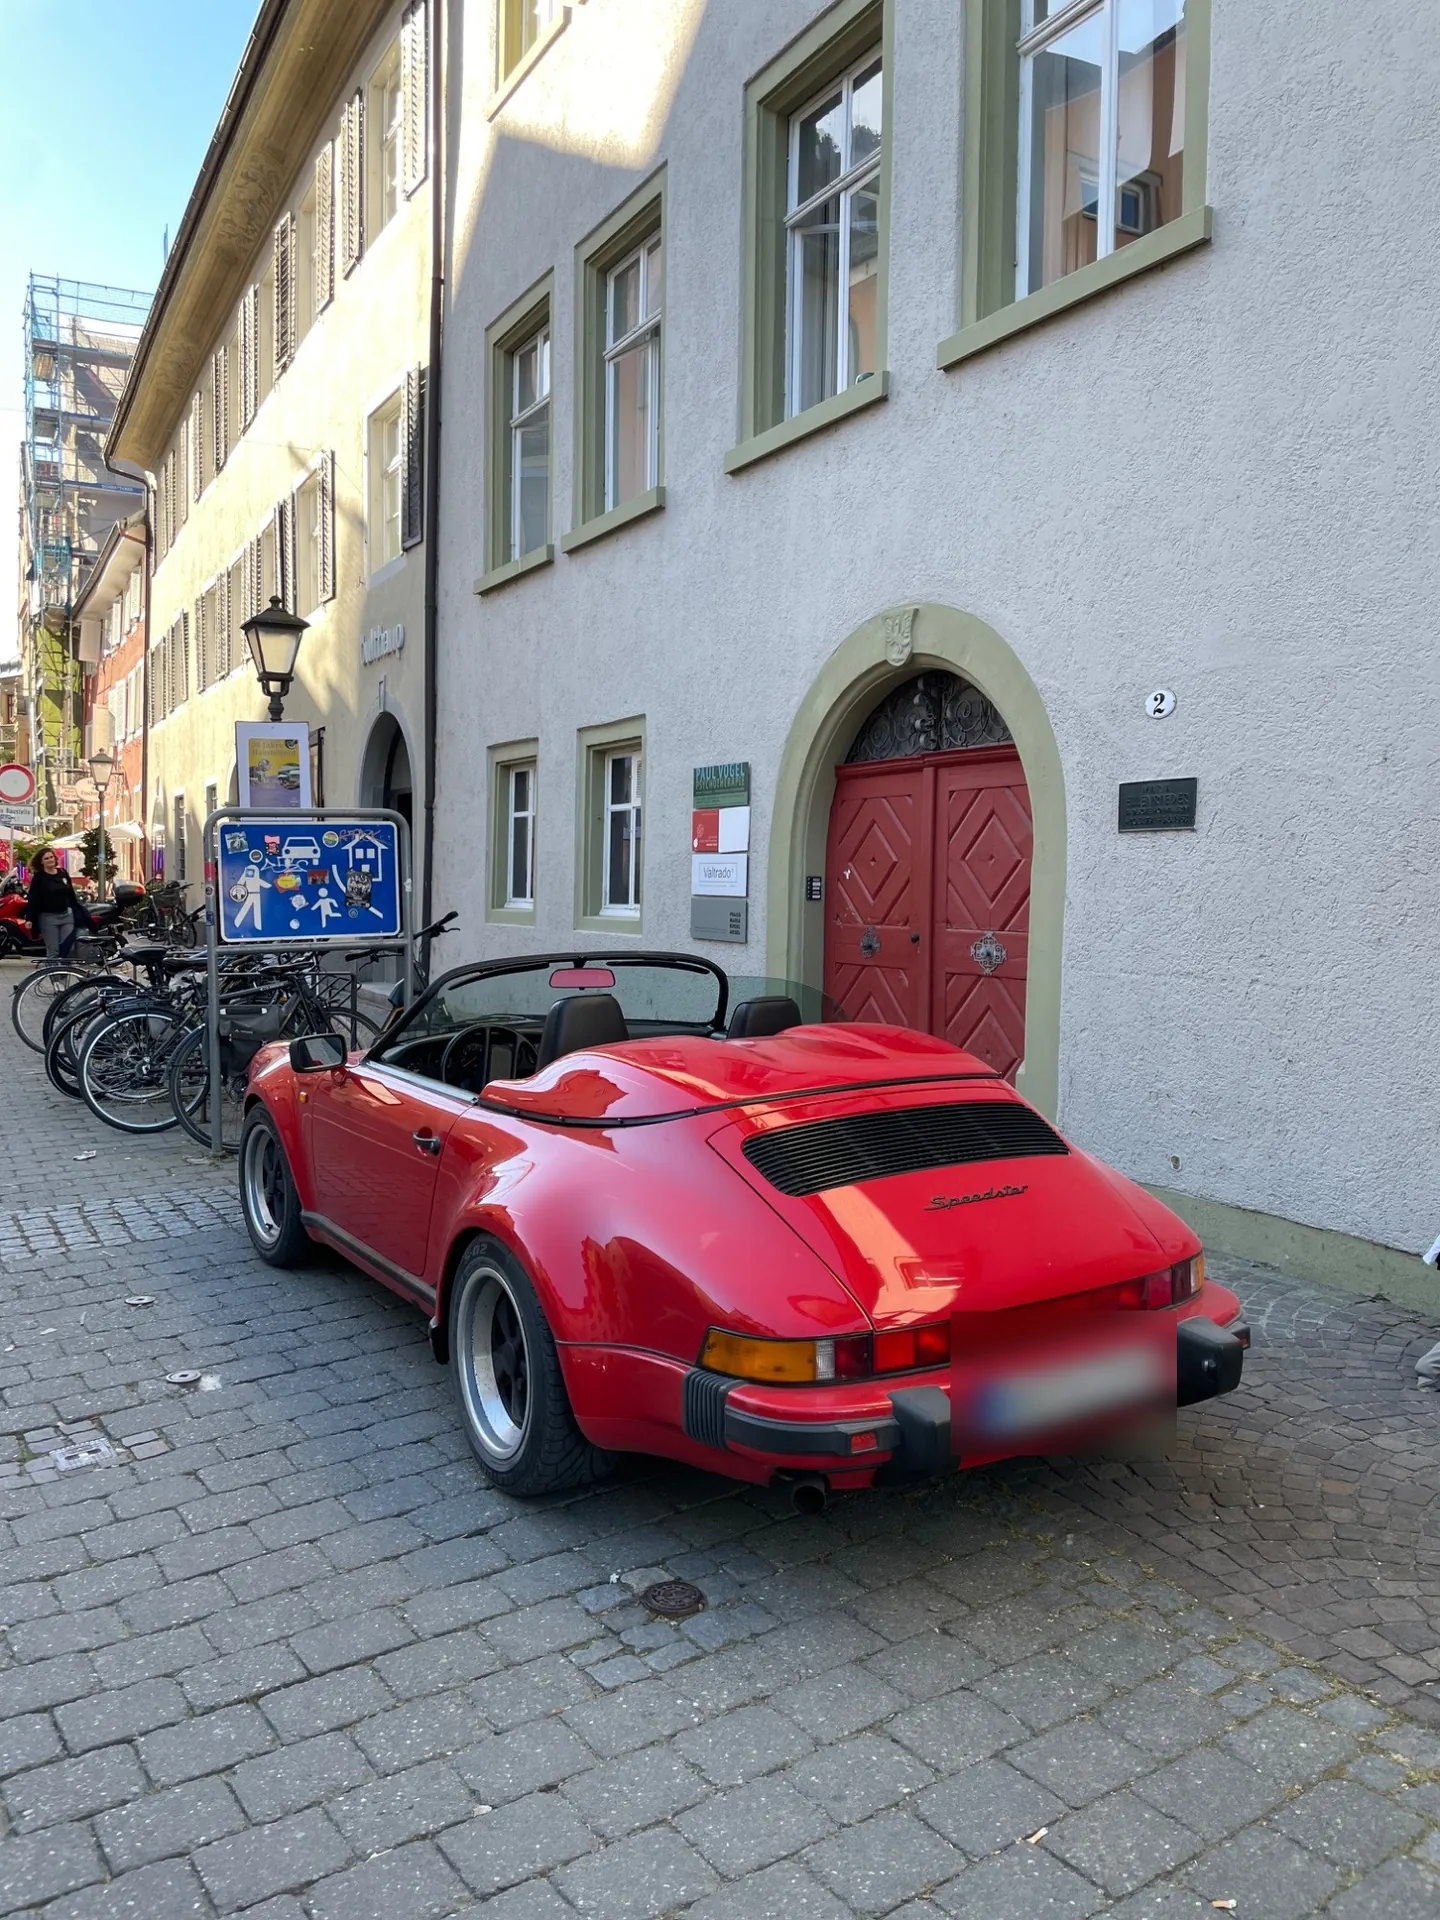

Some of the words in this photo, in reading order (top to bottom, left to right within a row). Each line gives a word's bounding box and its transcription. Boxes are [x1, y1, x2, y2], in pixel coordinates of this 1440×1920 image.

[1152, 692, 1165, 715] 2
[695, 766, 716, 781] PAUL
[718, 763, 745, 778] VOGEL
[703, 866, 731, 879] Valtrado
[924, 1185, 1028, 1210] Speedster
